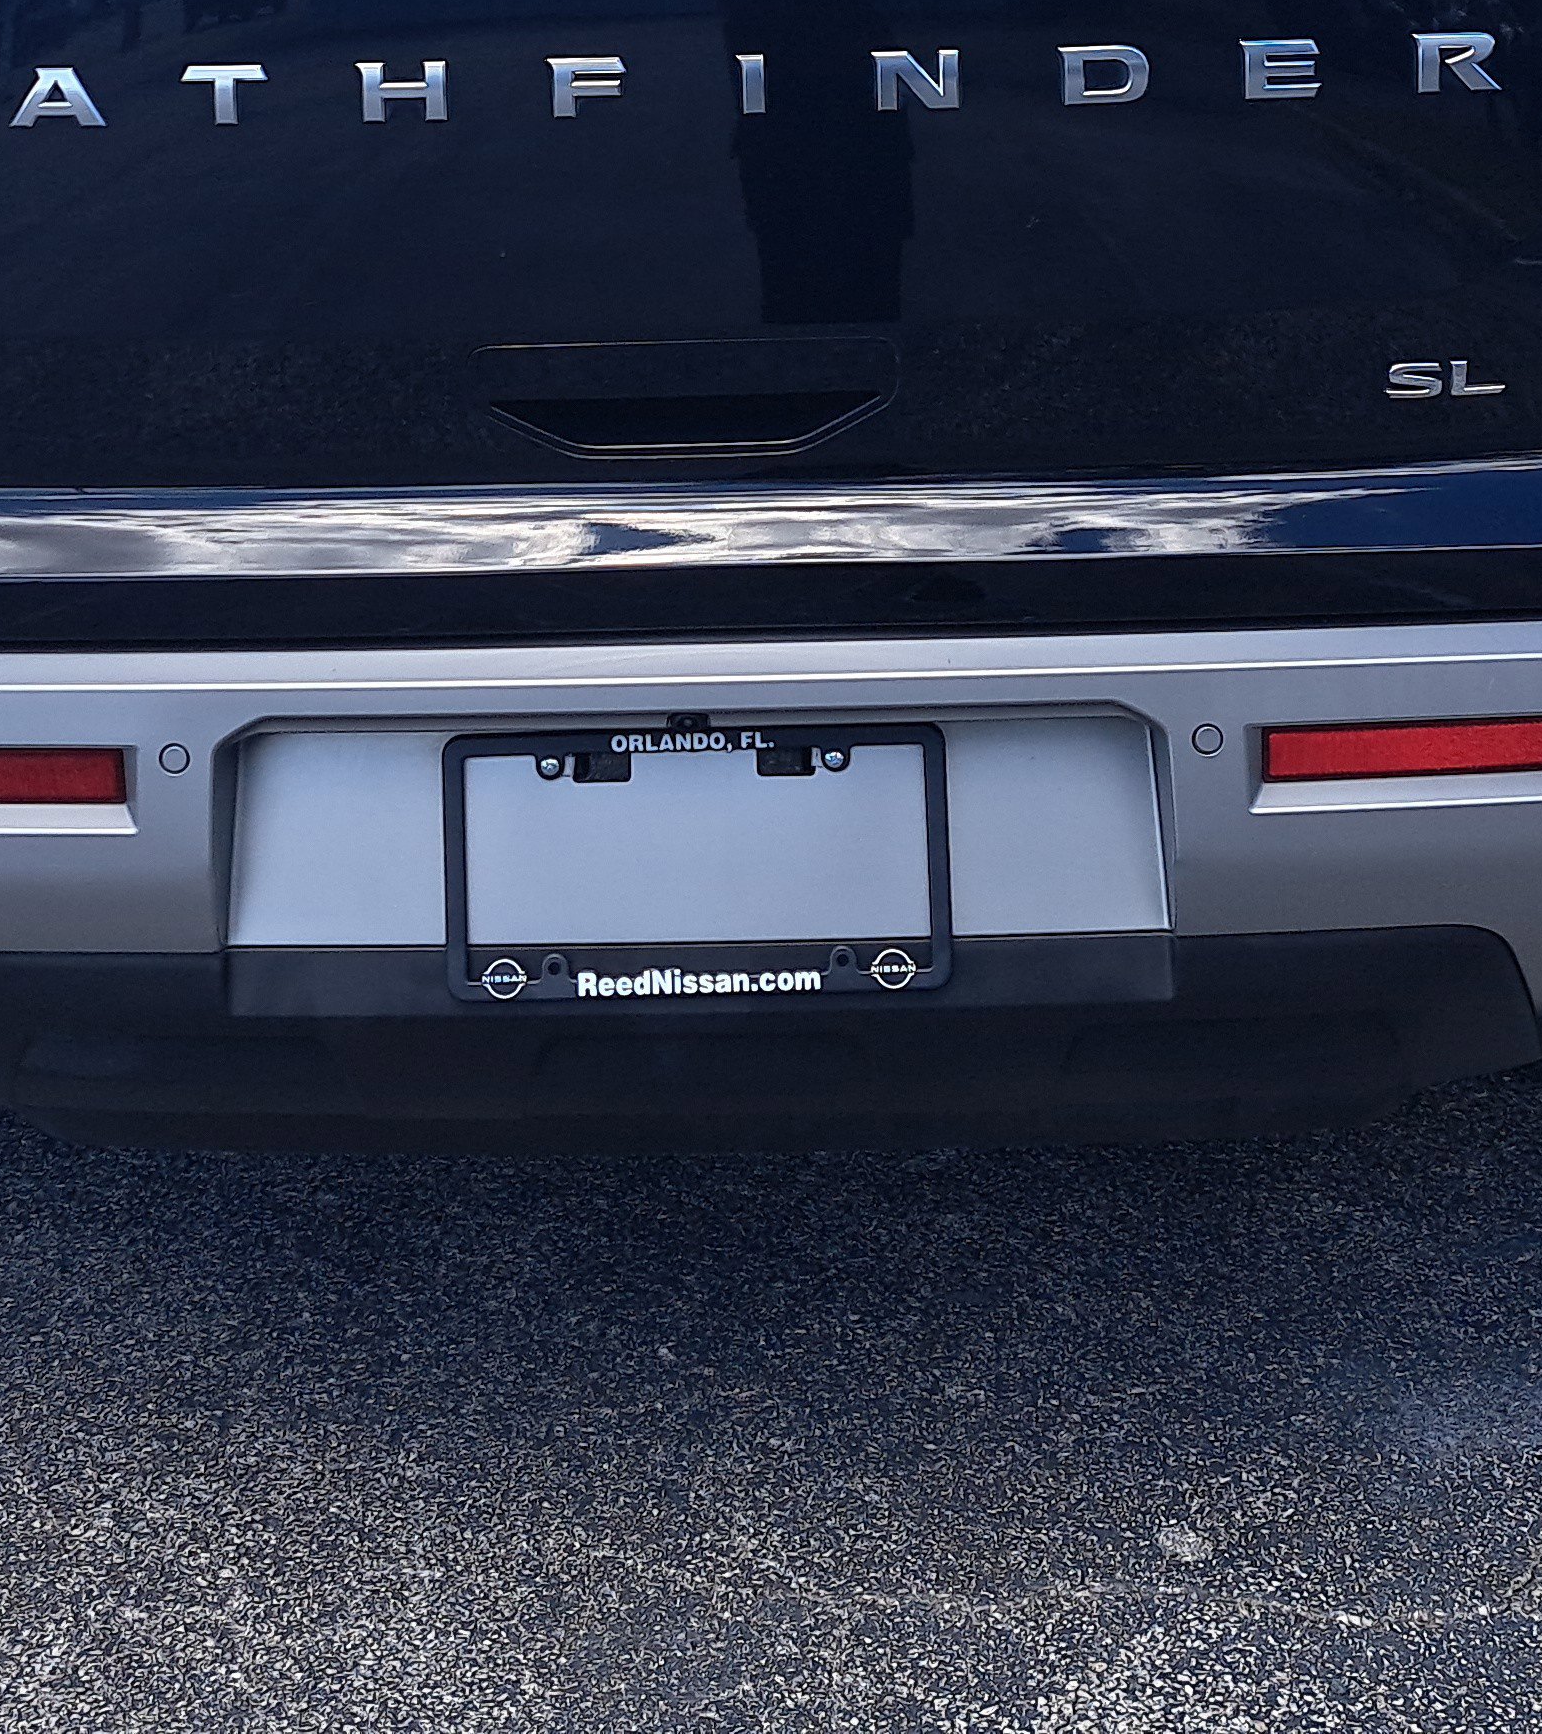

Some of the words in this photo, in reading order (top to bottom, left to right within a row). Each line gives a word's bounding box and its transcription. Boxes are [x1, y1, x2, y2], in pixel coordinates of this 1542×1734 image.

[1384, 359, 1506, 399] SL
[610, 731, 733, 753] ORLANDO,
[740, 731, 775, 749] FL.
[481, 974, 528, 983] NISSAN
[870, 963, 917, 973] NISSAN
[576, 968, 822, 998] ReedNissan.com
